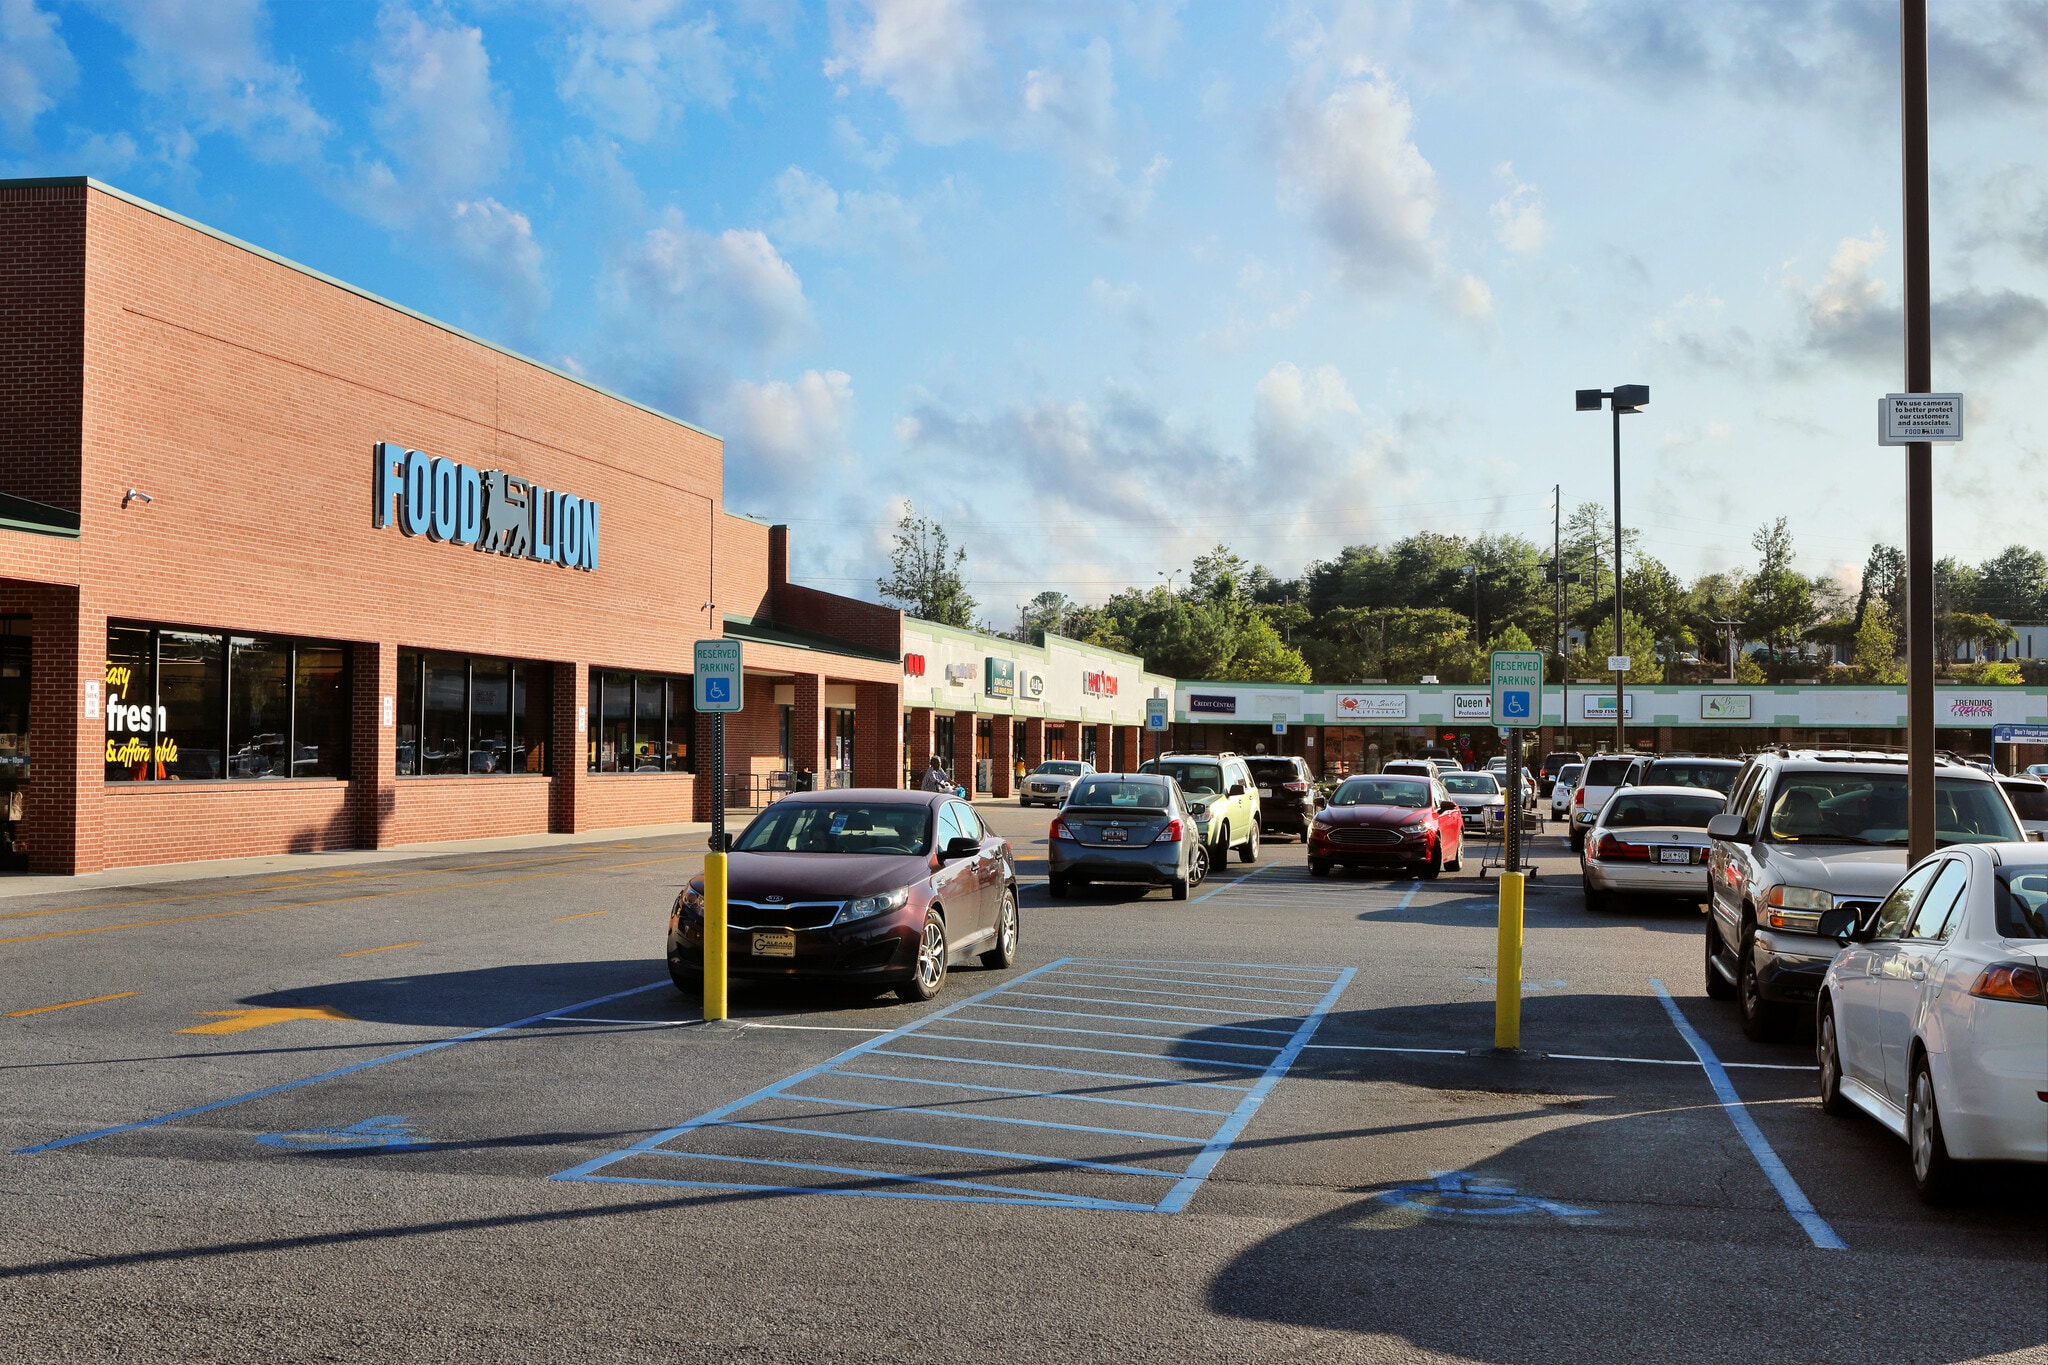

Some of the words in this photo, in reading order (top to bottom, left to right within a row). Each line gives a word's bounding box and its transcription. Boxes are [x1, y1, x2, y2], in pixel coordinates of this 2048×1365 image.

[377, 441, 481, 545] FOOD
[532, 485, 599, 571] LION
[698, 650, 737, 659] RESERVED
[700, 663, 735, 672] PARKING
[1495, 661, 1539, 671] RESERVED
[1497, 676, 1536, 686] PARKING
[1456, 697, 1482, 708] Queen
[106, 693, 166, 732] fresh
[1950, 704, 1994, 714] Topics
[106, 739, 116, 762] &
